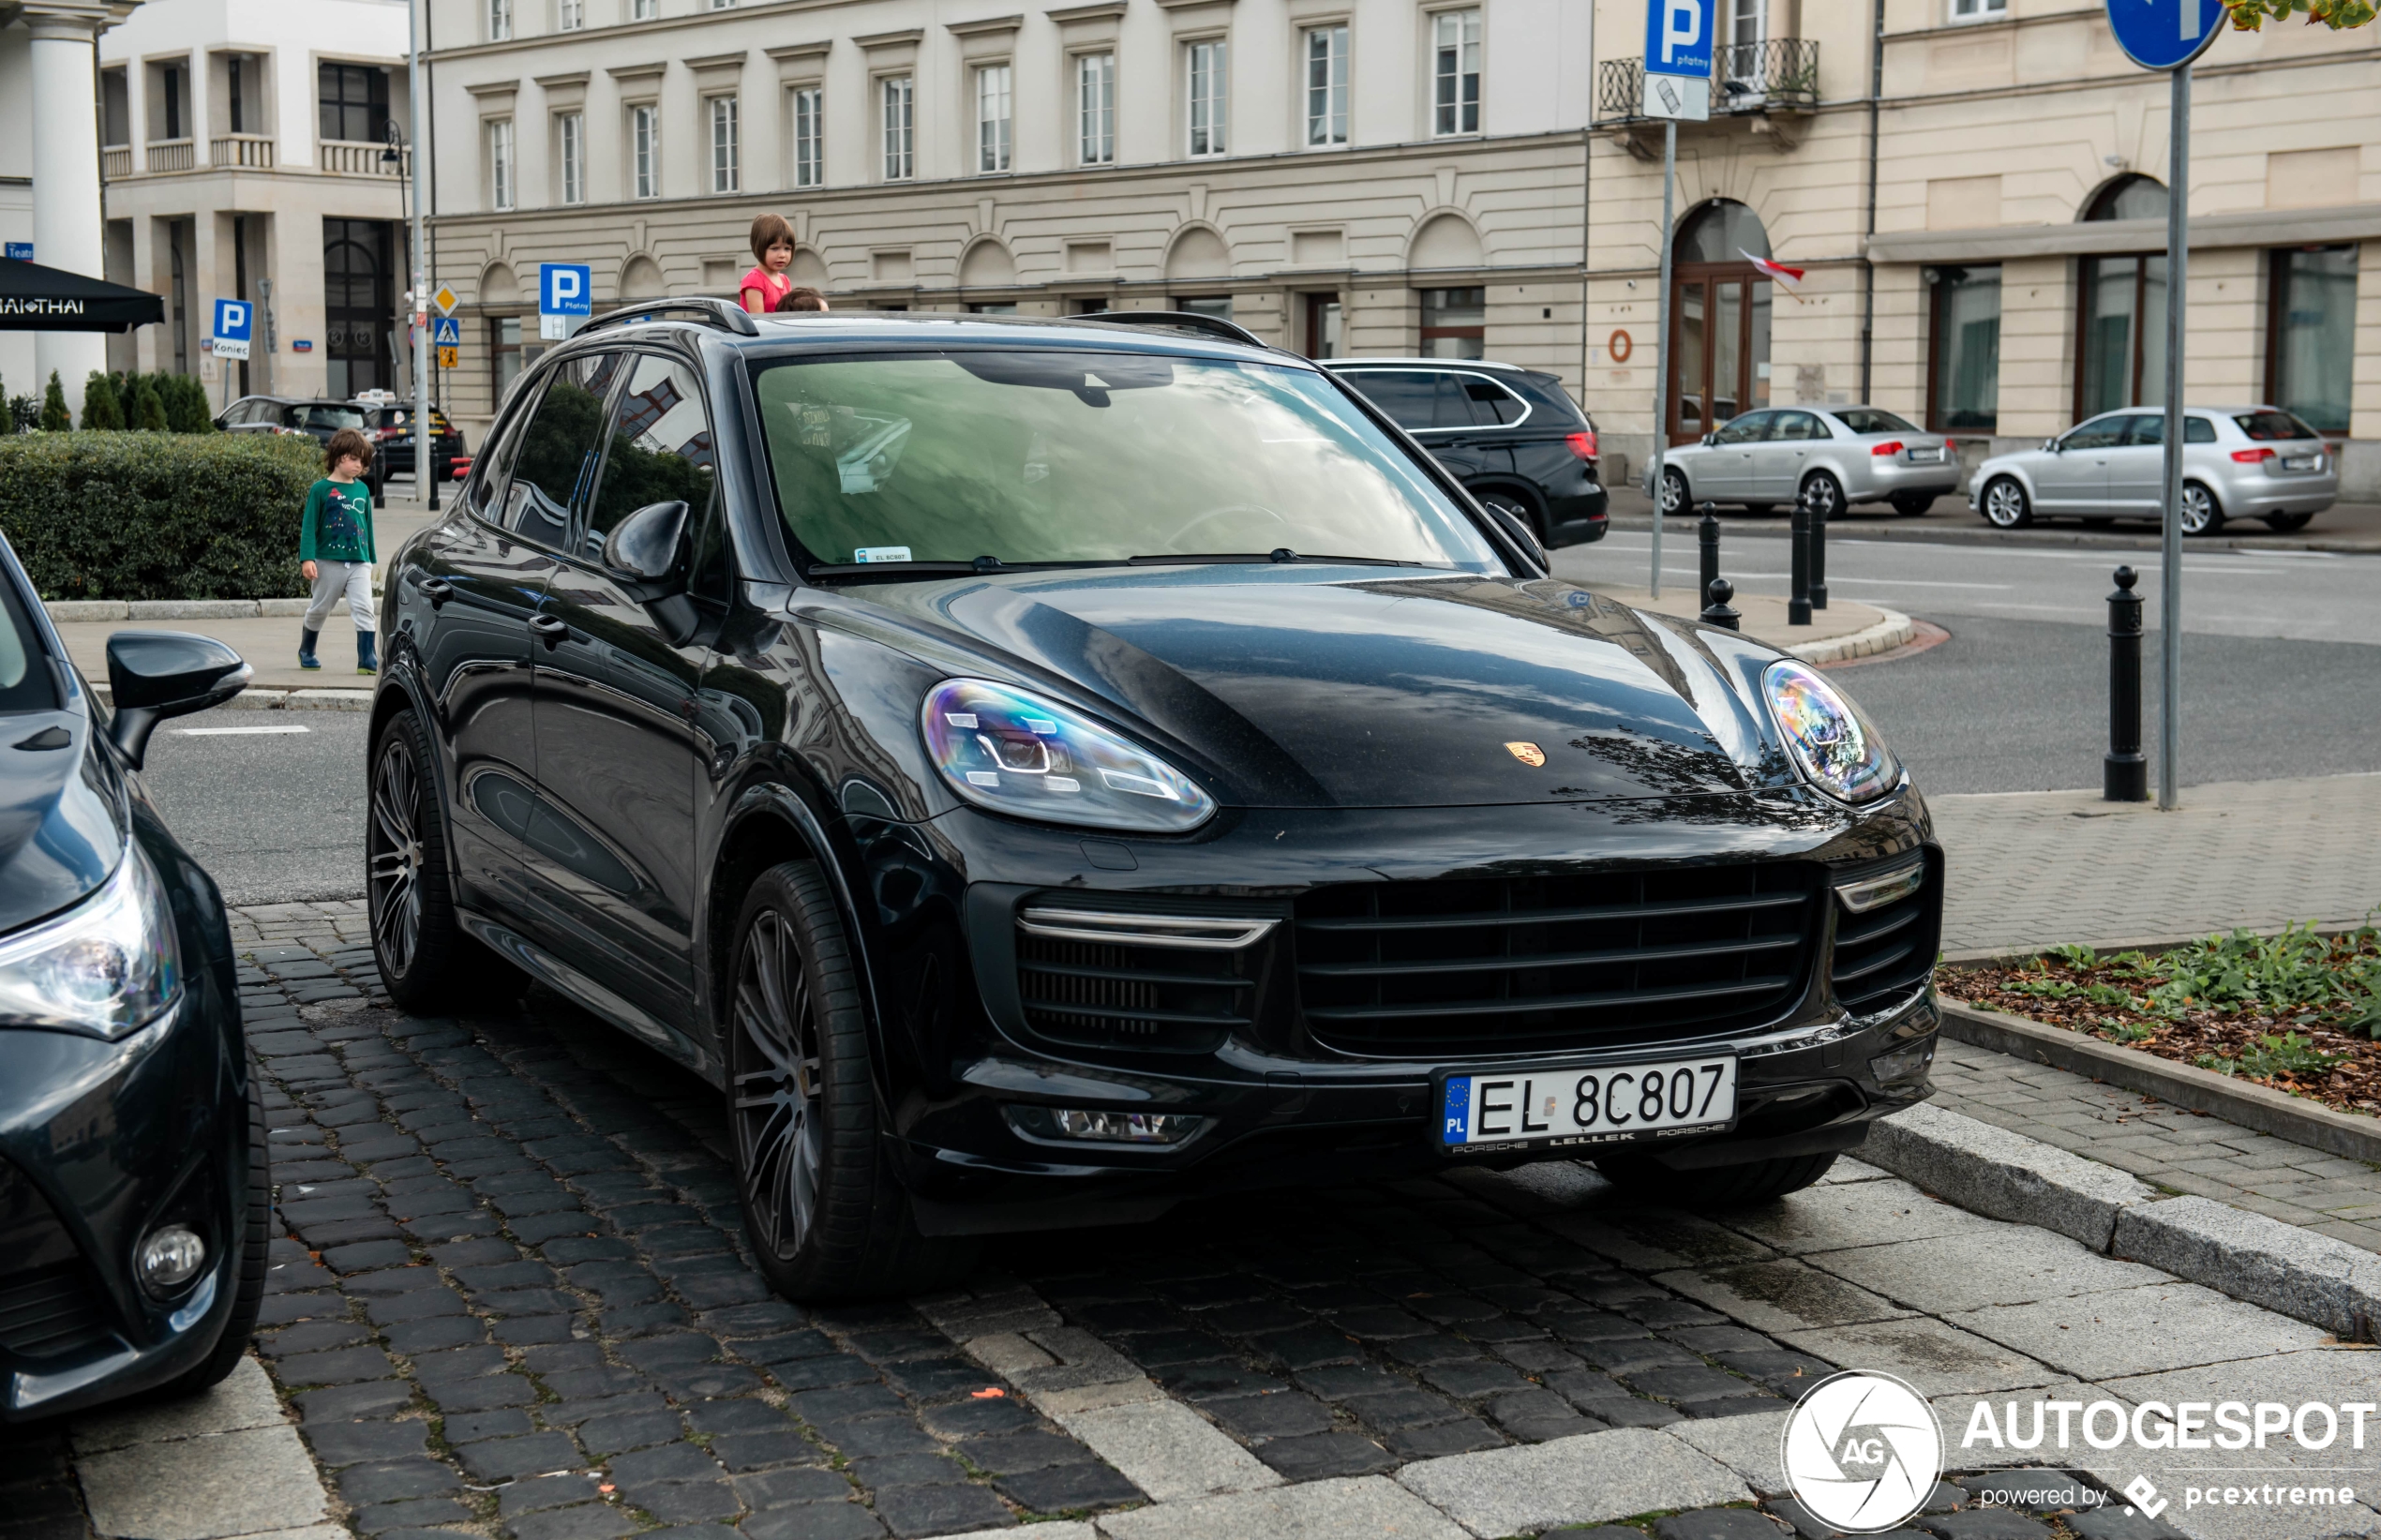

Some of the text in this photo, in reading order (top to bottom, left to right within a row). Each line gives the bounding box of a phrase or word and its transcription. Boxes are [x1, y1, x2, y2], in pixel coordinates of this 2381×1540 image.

[1677, 54, 1709, 70] płatny
[552, 269, 580, 309] P
[0, 298, 84, 314] AI THAI
[222, 304, 245, 335] P
[214, 341, 247, 355] Koniec
[1446, 1063, 1725, 1136] PL EL 8C807
[1452, 1123, 1726, 1155] PORSCHE LELLEK PORSCHE
